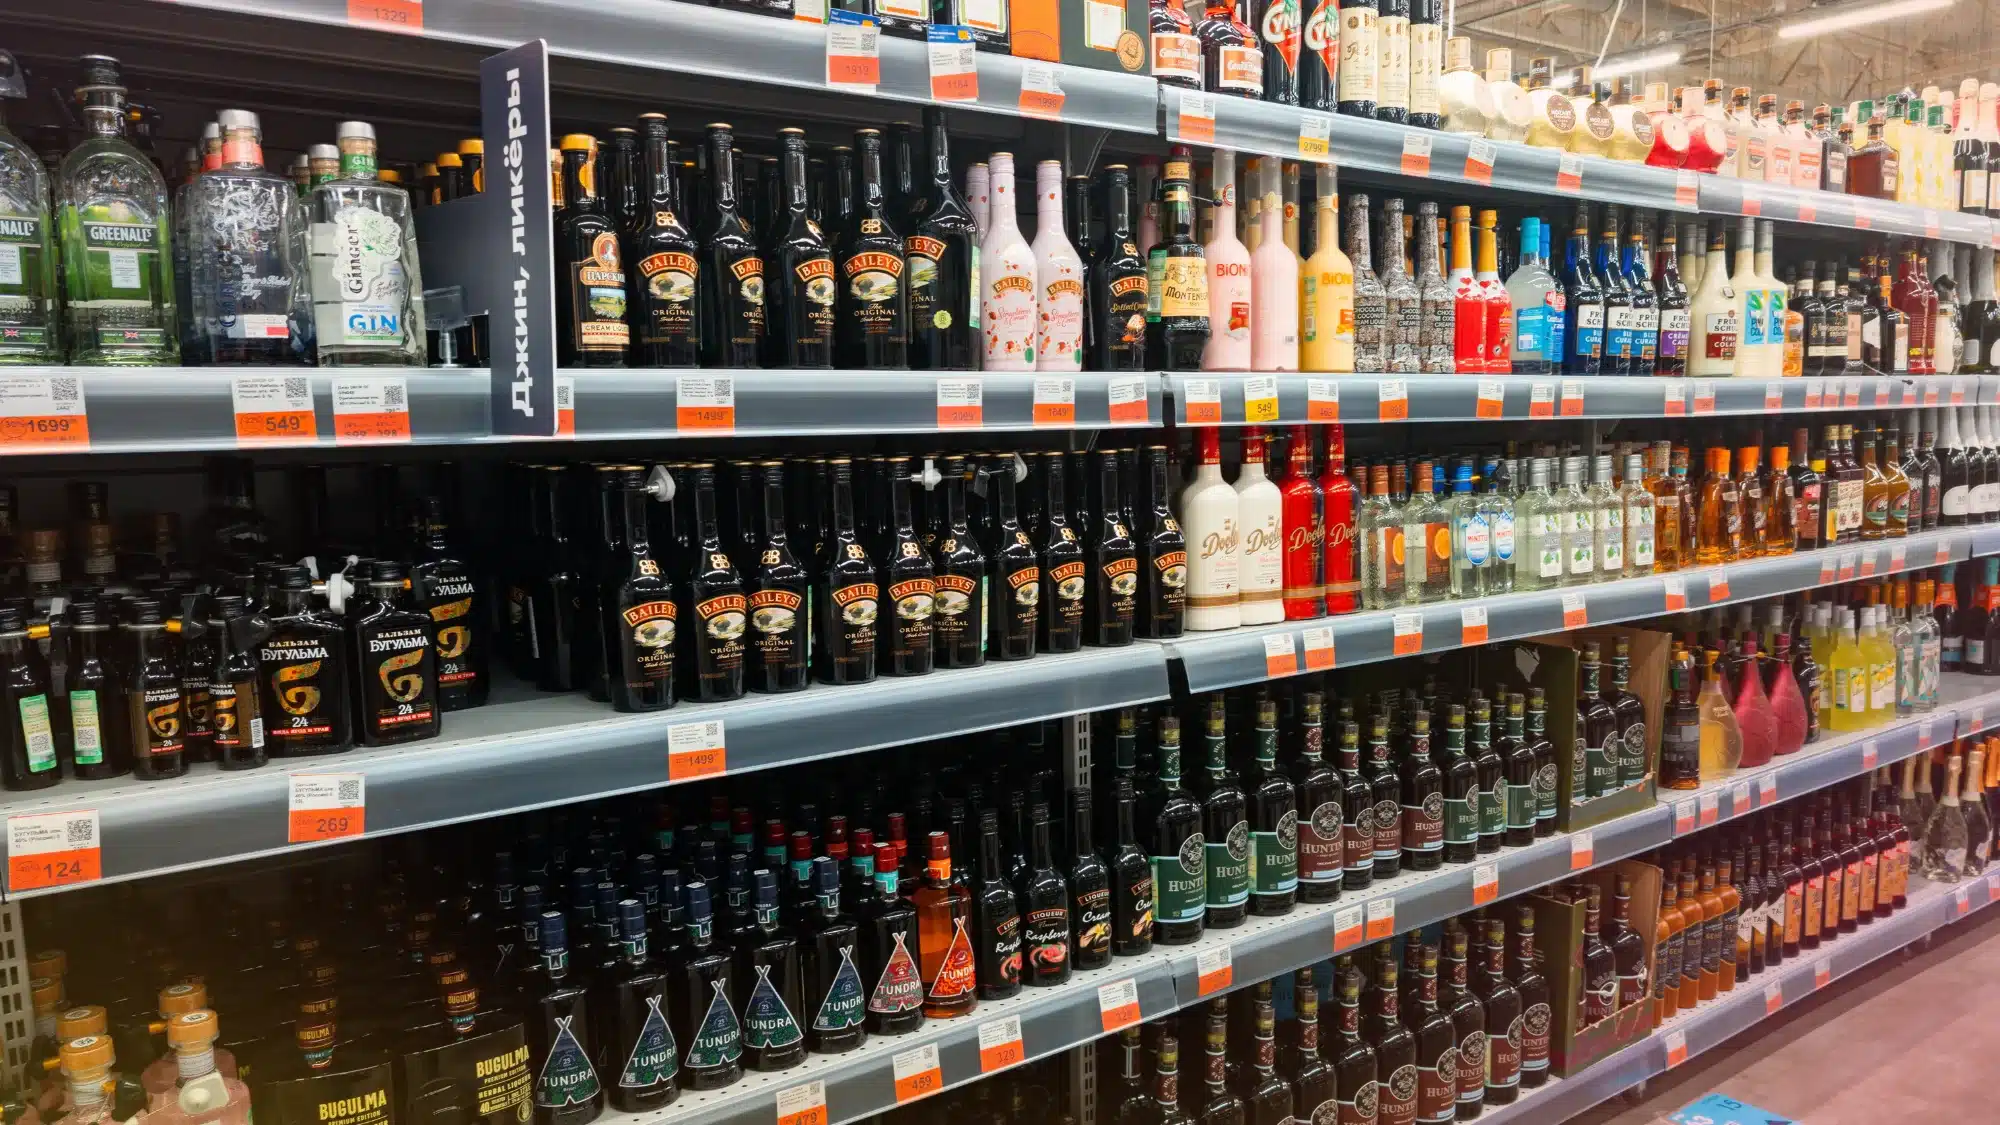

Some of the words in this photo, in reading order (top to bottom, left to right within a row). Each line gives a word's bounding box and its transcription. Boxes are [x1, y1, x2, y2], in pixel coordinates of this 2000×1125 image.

[503, 67, 529, 256] ликёры
[643, 255, 697, 273] BAILEYS
[846, 255, 901, 272] BAILEYS
[994, 278, 1033, 291] BAILEYS
[652, 309, 695, 317] ORIGINAL
[854, 309, 897, 317] ORIGINAL
[348, 314, 397, 333] GIN
[511, 266, 534, 418] Джин,
[1256, 402, 1272, 414] 549
[27, 418, 70, 433] 1699
[265, 414, 300, 432] 549
[629, 604, 677, 622] BAILEYS
[377, 628, 422, 640] БАЛЬЗАМ
[267, 639, 320, 648] БАЛЬЗАМ
[369, 635, 430, 653] БУГУЛЬМА
[260, 647, 329, 661] БУГУЛЬМА
[637, 652, 675, 663] ORIGINAL
[444, 663, 459, 674] 24
[144, 692, 180, 703] БУГУЛЬМА
[397, 703, 414, 715] 24
[291, 716, 309, 728] 24
[162, 739, 173, 748] 24
[688, 753, 715, 767] 1499
[315, 816, 349, 833] 269
[43, 859, 82, 879] 124
[1032, 910, 1064, 920] LIQUEUR
[1025, 928, 1069, 943] Raspberry
[879, 979, 921, 996] TUNDRA
[825, 993, 865, 1012] TUNDRA
[746, 1016, 793, 1030] TUNDRA
[698, 1028, 742, 1049] TUNDRA
[475, 1044, 530, 1079] BUGULMA
[632, 1046, 677, 1068] TUNDRA
[542, 1067, 594, 1088] TUNDRA
[478, 1084, 506, 1099] HERBAL
[318, 1088, 388, 1121] BUGULMA
[479, 1101, 491, 1114] 40
[356, 1109, 381, 1121] EDITION
